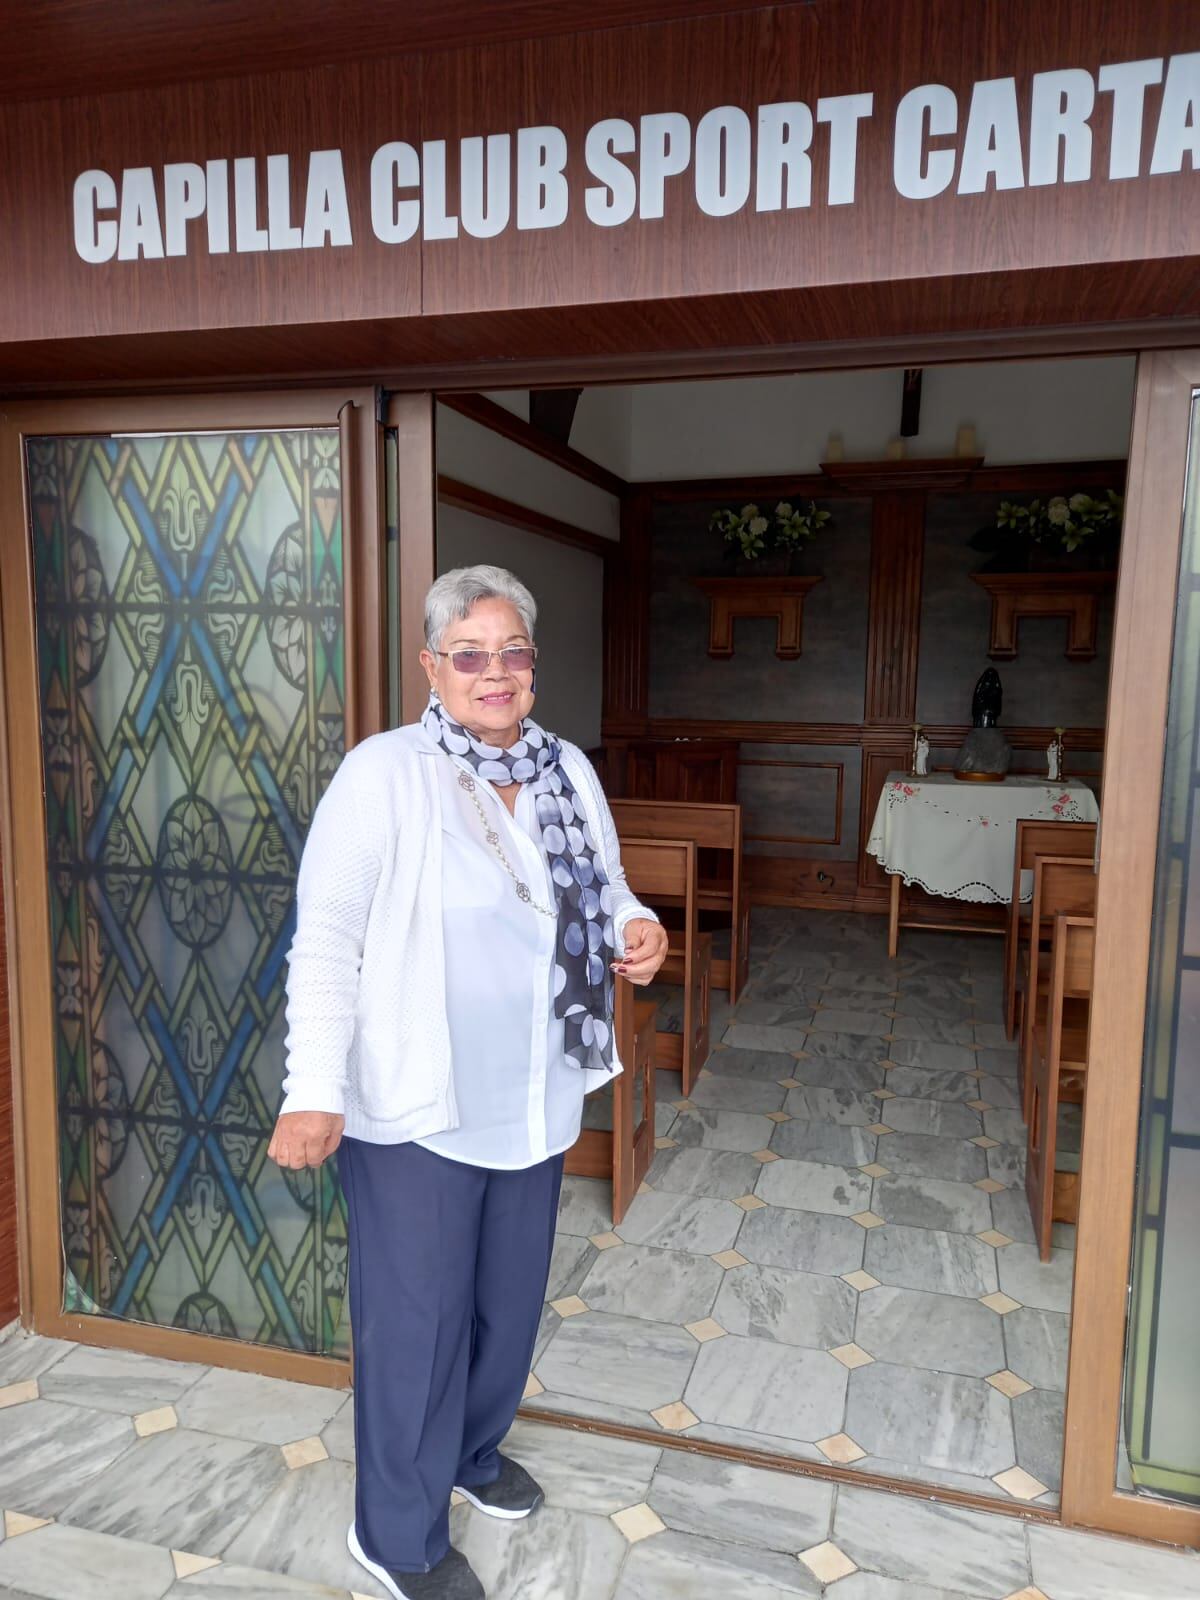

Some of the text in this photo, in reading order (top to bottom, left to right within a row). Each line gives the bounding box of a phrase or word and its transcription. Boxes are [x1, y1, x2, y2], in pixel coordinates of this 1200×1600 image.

[73, 150, 353, 264] CAPILLA
[370, 126, 569, 244] CLUB
[584, 93, 874, 227] SPORT
